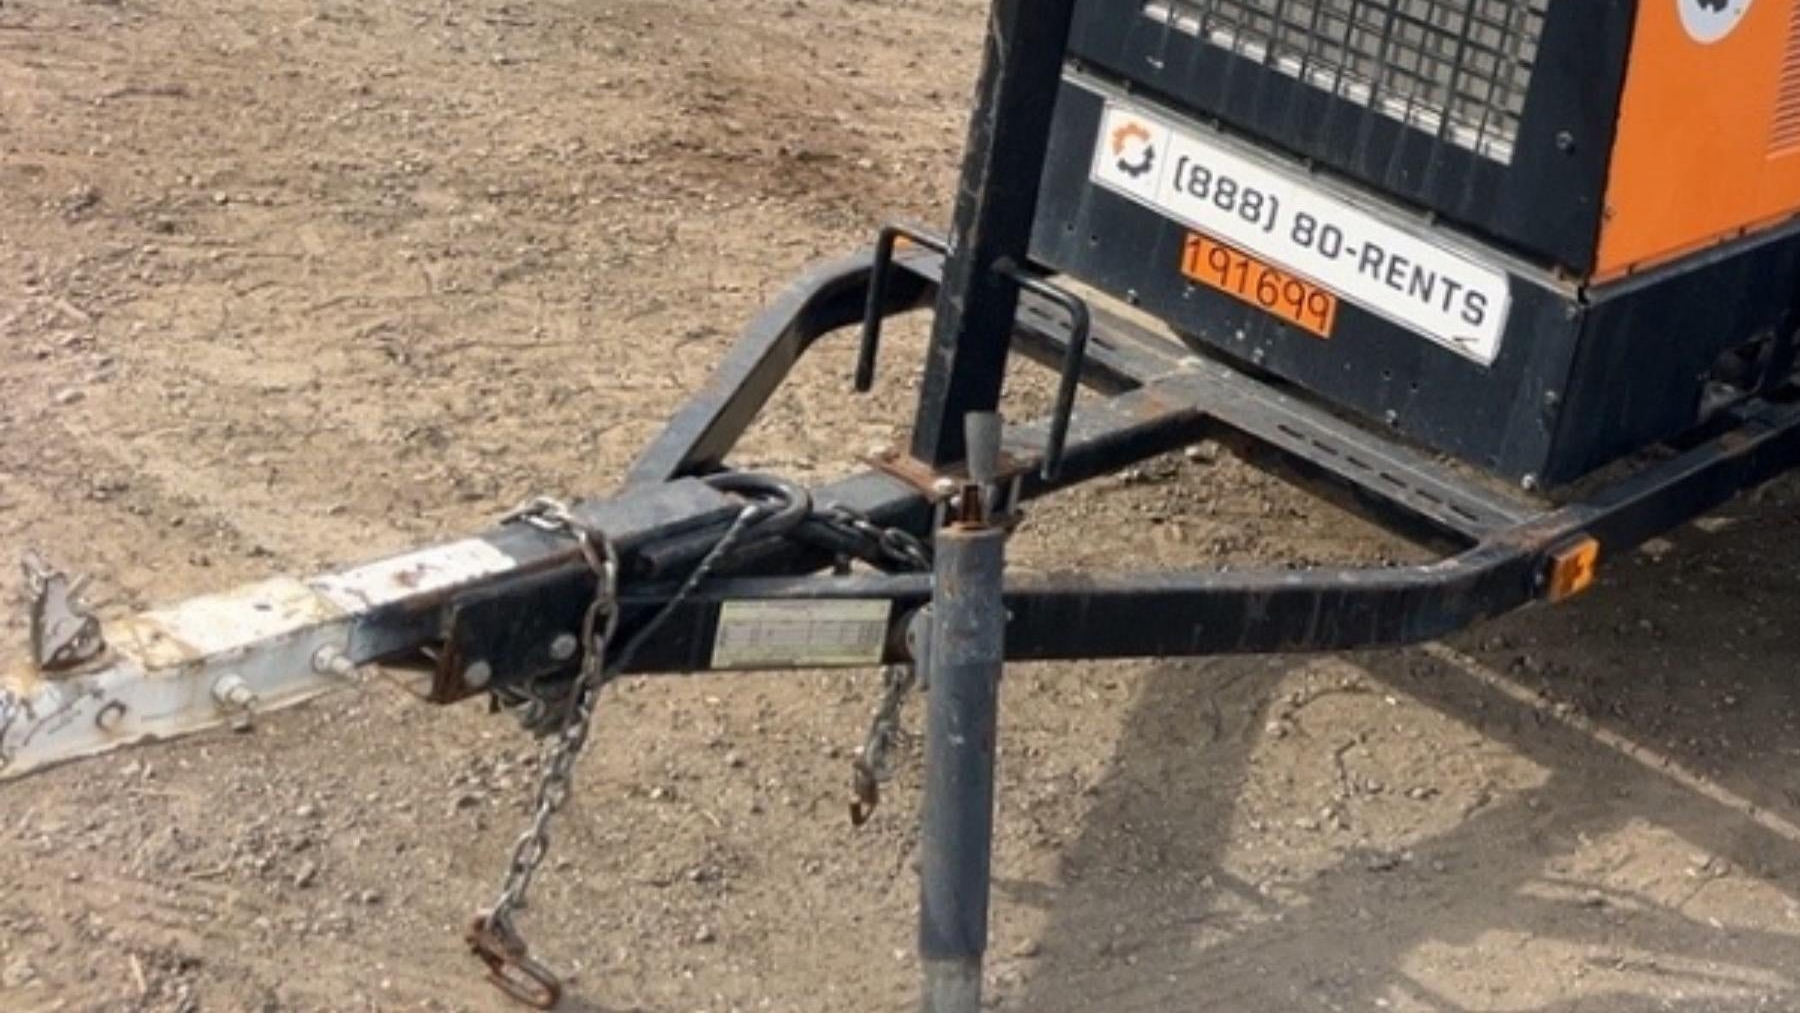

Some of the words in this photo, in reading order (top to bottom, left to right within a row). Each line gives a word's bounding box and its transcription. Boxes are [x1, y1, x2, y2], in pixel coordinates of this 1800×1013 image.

[1172, 155, 1279, 233] (888)
[1291, 212, 1489, 328] 80-RENTS
[1186, 235, 1331, 332] 191699
